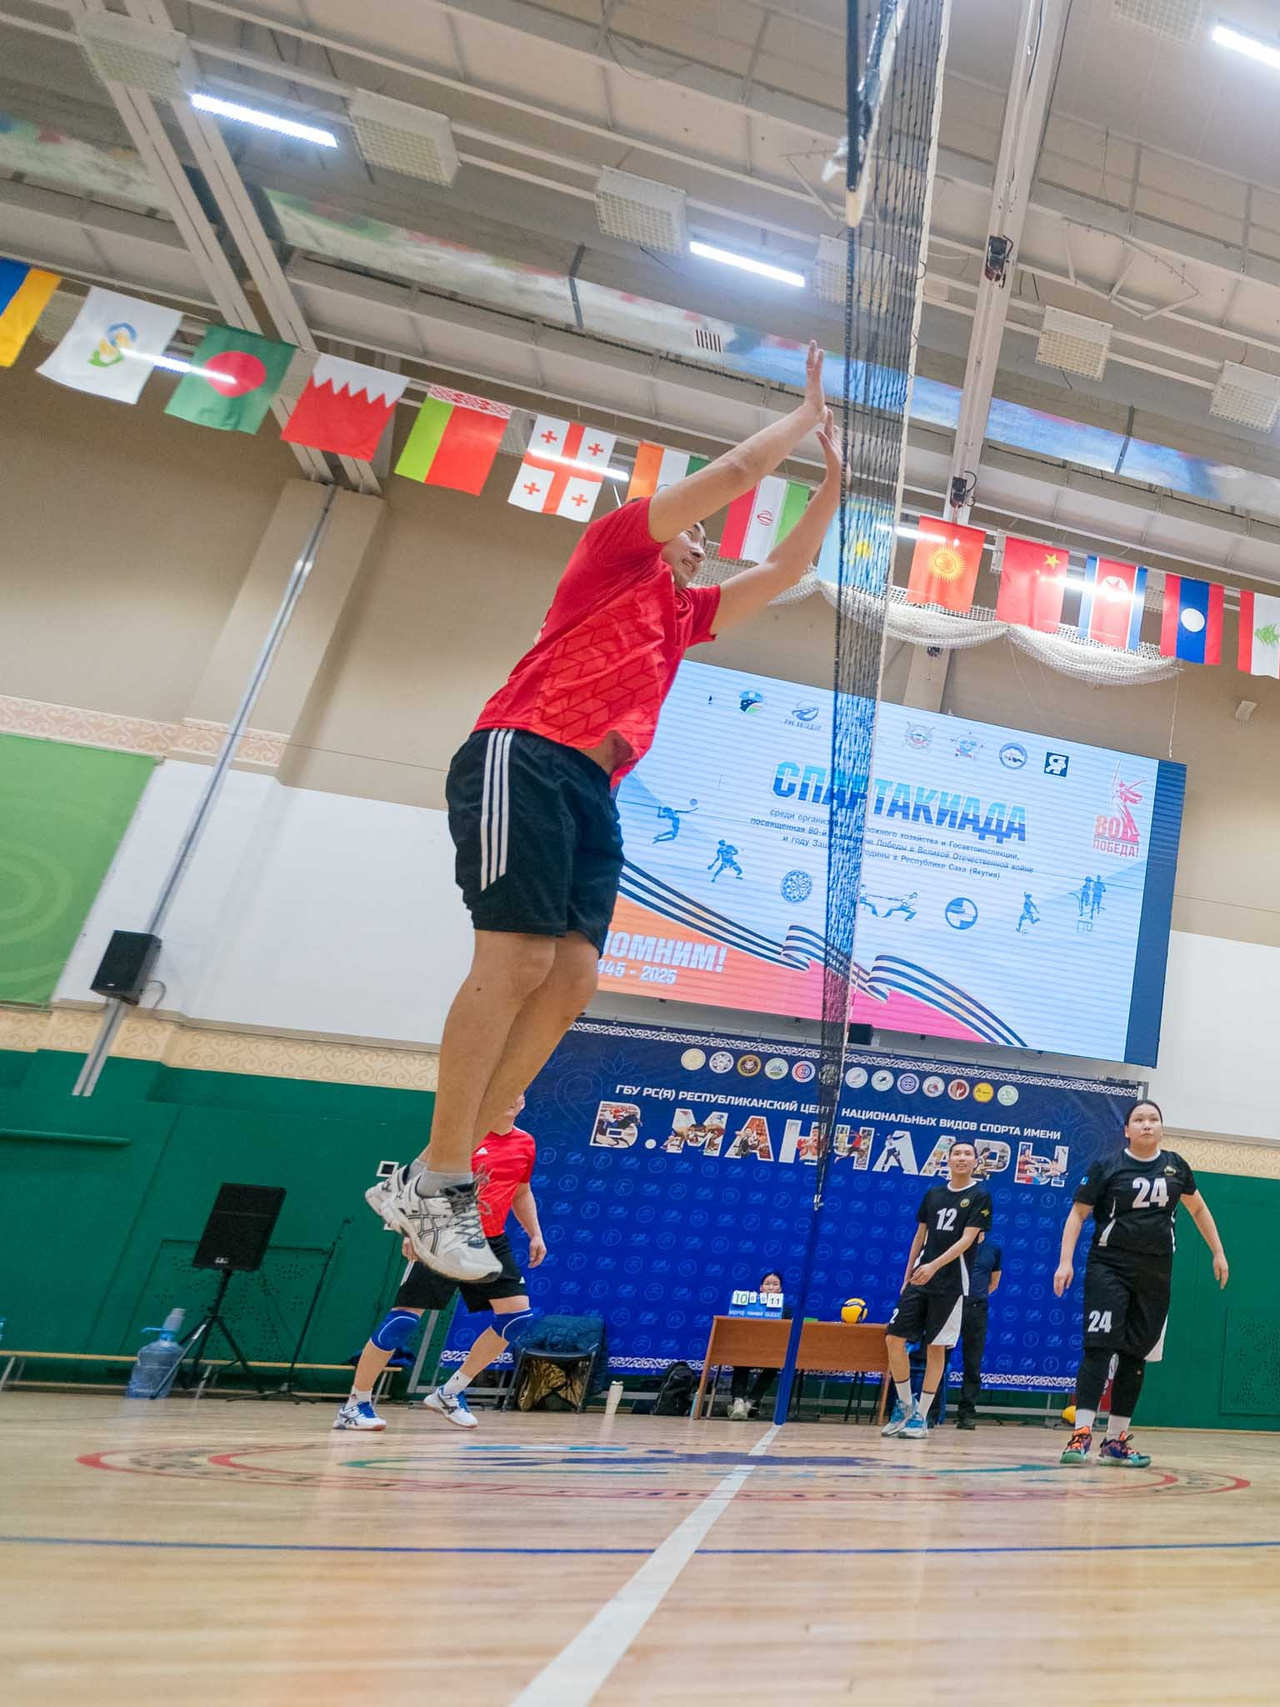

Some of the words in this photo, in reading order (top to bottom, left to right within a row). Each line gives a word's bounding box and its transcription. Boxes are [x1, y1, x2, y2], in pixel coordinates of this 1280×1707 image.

[770, 808, 795, 820] среди
[900, 832, 938, 845] хозяйства
[1094, 813, 1121, 838] 80
[791, 836, 810, 848] году
[877, 839, 907, 852] Победы
[918, 846, 950, 859] Великой
[1093, 839, 1140, 858] ПОБЕДА!
[901, 855, 946, 869] Республике
[949, 863, 967, 873] Саха
[969, 865, 1001, 880] (Якутия)
[640, 965, 678, 985] 2025
[615, 1084, 641, 1095] ГБУ
[642, 1087, 676, 1101] РС(Я)
[678, 1090, 798, 1112] РЕСПУБЛИКАНСКИЙ
[800, 1103, 832, 1115] ЦЕНТ
[841, 1107, 937, 1127] НАЦИОНАЛЬНЫХ
[939, 1118, 978, 1131] ВИДОВ
[979, 1123, 1021, 1136] СПОРТА
[1023, 1129, 1061, 1140] ИМЕНИ
[1131, 1177, 1169, 1209] 24
[936, 1208, 959, 1231] 12
[735, 1293, 748, 1304] 10
[1088, 1310, 1112, 1333] 24
